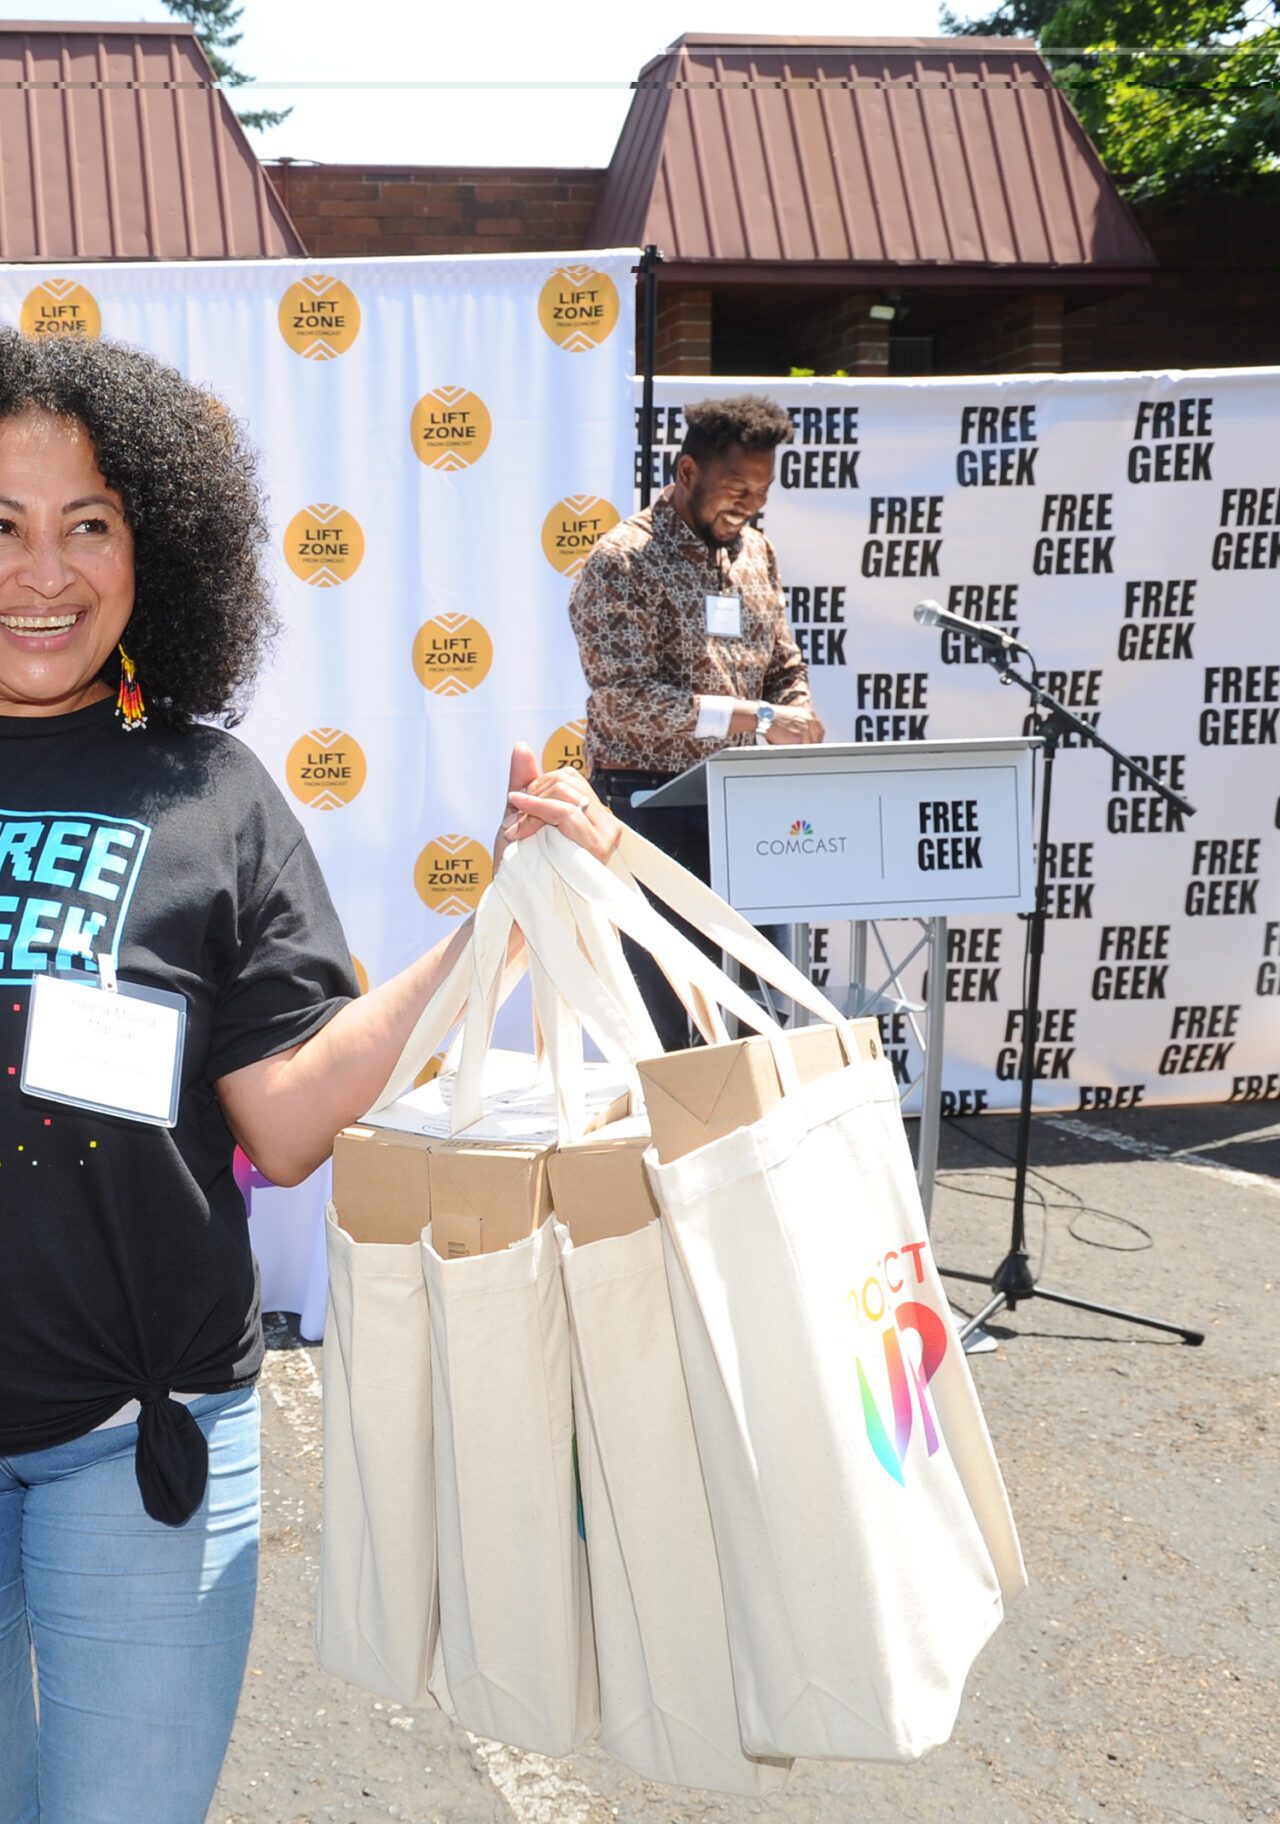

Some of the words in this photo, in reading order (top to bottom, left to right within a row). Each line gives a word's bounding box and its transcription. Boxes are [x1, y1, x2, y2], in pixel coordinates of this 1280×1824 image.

[41, 305, 80, 318] LIFT
[300, 301, 339, 313] LIFT
[553, 305, 604, 319] ZONE
[559, 290, 599, 304] LIFT
[35, 320, 86, 332] ZONE
[293, 316, 345, 328] ZONE
[423, 426, 476, 439] ZONE
[431, 412, 470, 424] LIFT
[960, 405, 1037, 444] FREE
[1133, 398, 1213, 440] FREE
[780, 451, 861, 489] GEEK
[956, 447, 1039, 487] GEEK
[1127, 442, 1214, 484] GEEK
[562, 518, 602, 533] LIFT
[869, 496, 944, 534] FREE
[1040, 493, 1113, 532] FREE
[298, 543, 349, 555] ZONE
[306, 529, 344, 541] LIFT
[861, 539, 943, 578] GEEK
[1032, 536, 1115, 576] GEEK
[948, 584, 1019, 622] FREE
[1124, 579, 1197, 618] FREE
[425, 652, 477, 664] ZONE
[433, 638, 472, 650] LIFT
[795, 628, 847, 666] EEK
[1117, 622, 1195, 661] GEEK
[857, 673, 928, 710] FREE
[1029, 670, 1103, 707] FREE
[1204, 665, 1280, 703] FREE
[1199, 708, 1280, 746] GEEK
[308, 753, 346, 765] LIFT
[557, 759, 583, 771] ZO
[564, 745, 580, 756] LI
[300, 767, 352, 779] ZONE
[1112, 754, 1186, 792] FREE
[919, 800, 979, 834] FREE
[756, 837, 847, 856] COMCAST
[917, 837, 983, 871] GEEK
[1033, 842, 1094, 878] REE
[1192, 838, 1261, 875] FREE
[428, 873, 479, 885] ZONE
[434, 859, 474, 871] LIFT
[1185, 879, 1259, 917] GEEK
[946, 928, 1002, 963] REE
[1099, 925, 1170, 961] FREE
[1091, 965, 1169, 1001] GEEK
[1170, 1004, 1241, 1039] FREE
[1158, 1042, 1235, 1076] GEEK
